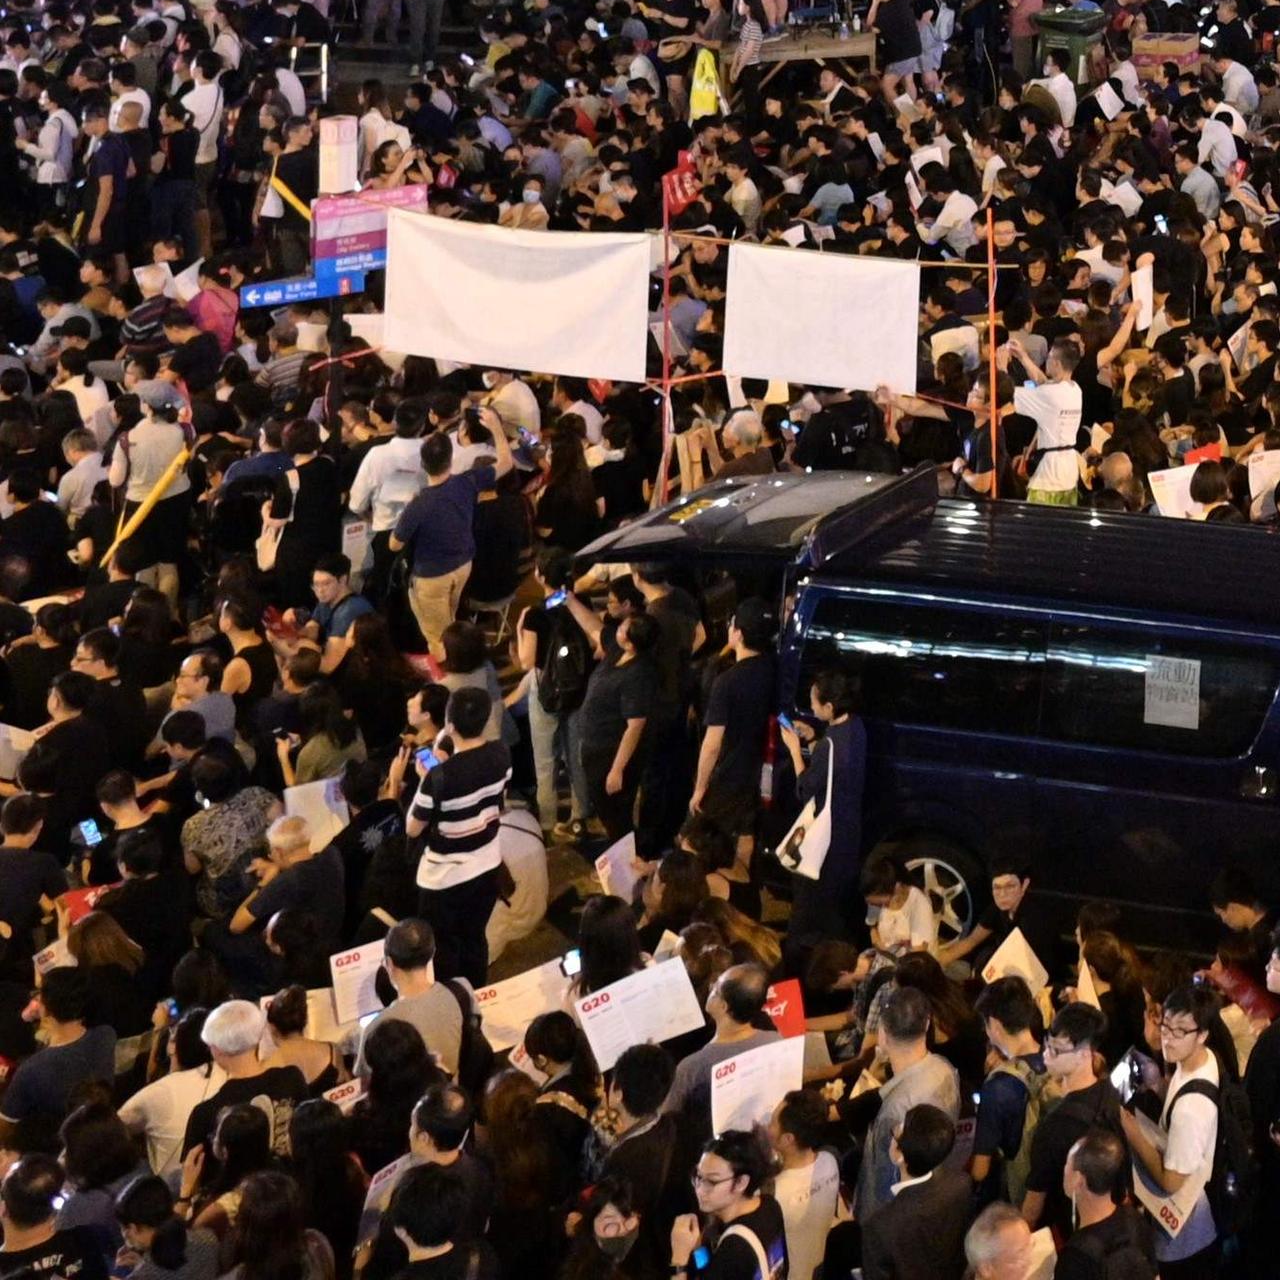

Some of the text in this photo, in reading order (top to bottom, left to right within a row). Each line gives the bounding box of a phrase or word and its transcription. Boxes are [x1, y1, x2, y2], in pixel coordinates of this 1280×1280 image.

[335, 951, 362, 969] G20
[581, 992, 611, 1013] G20
[715, 1061, 738, 1081] G20
[329, 1085, 356, 1102] G20
[1159, 1204, 1180, 1230] G20
